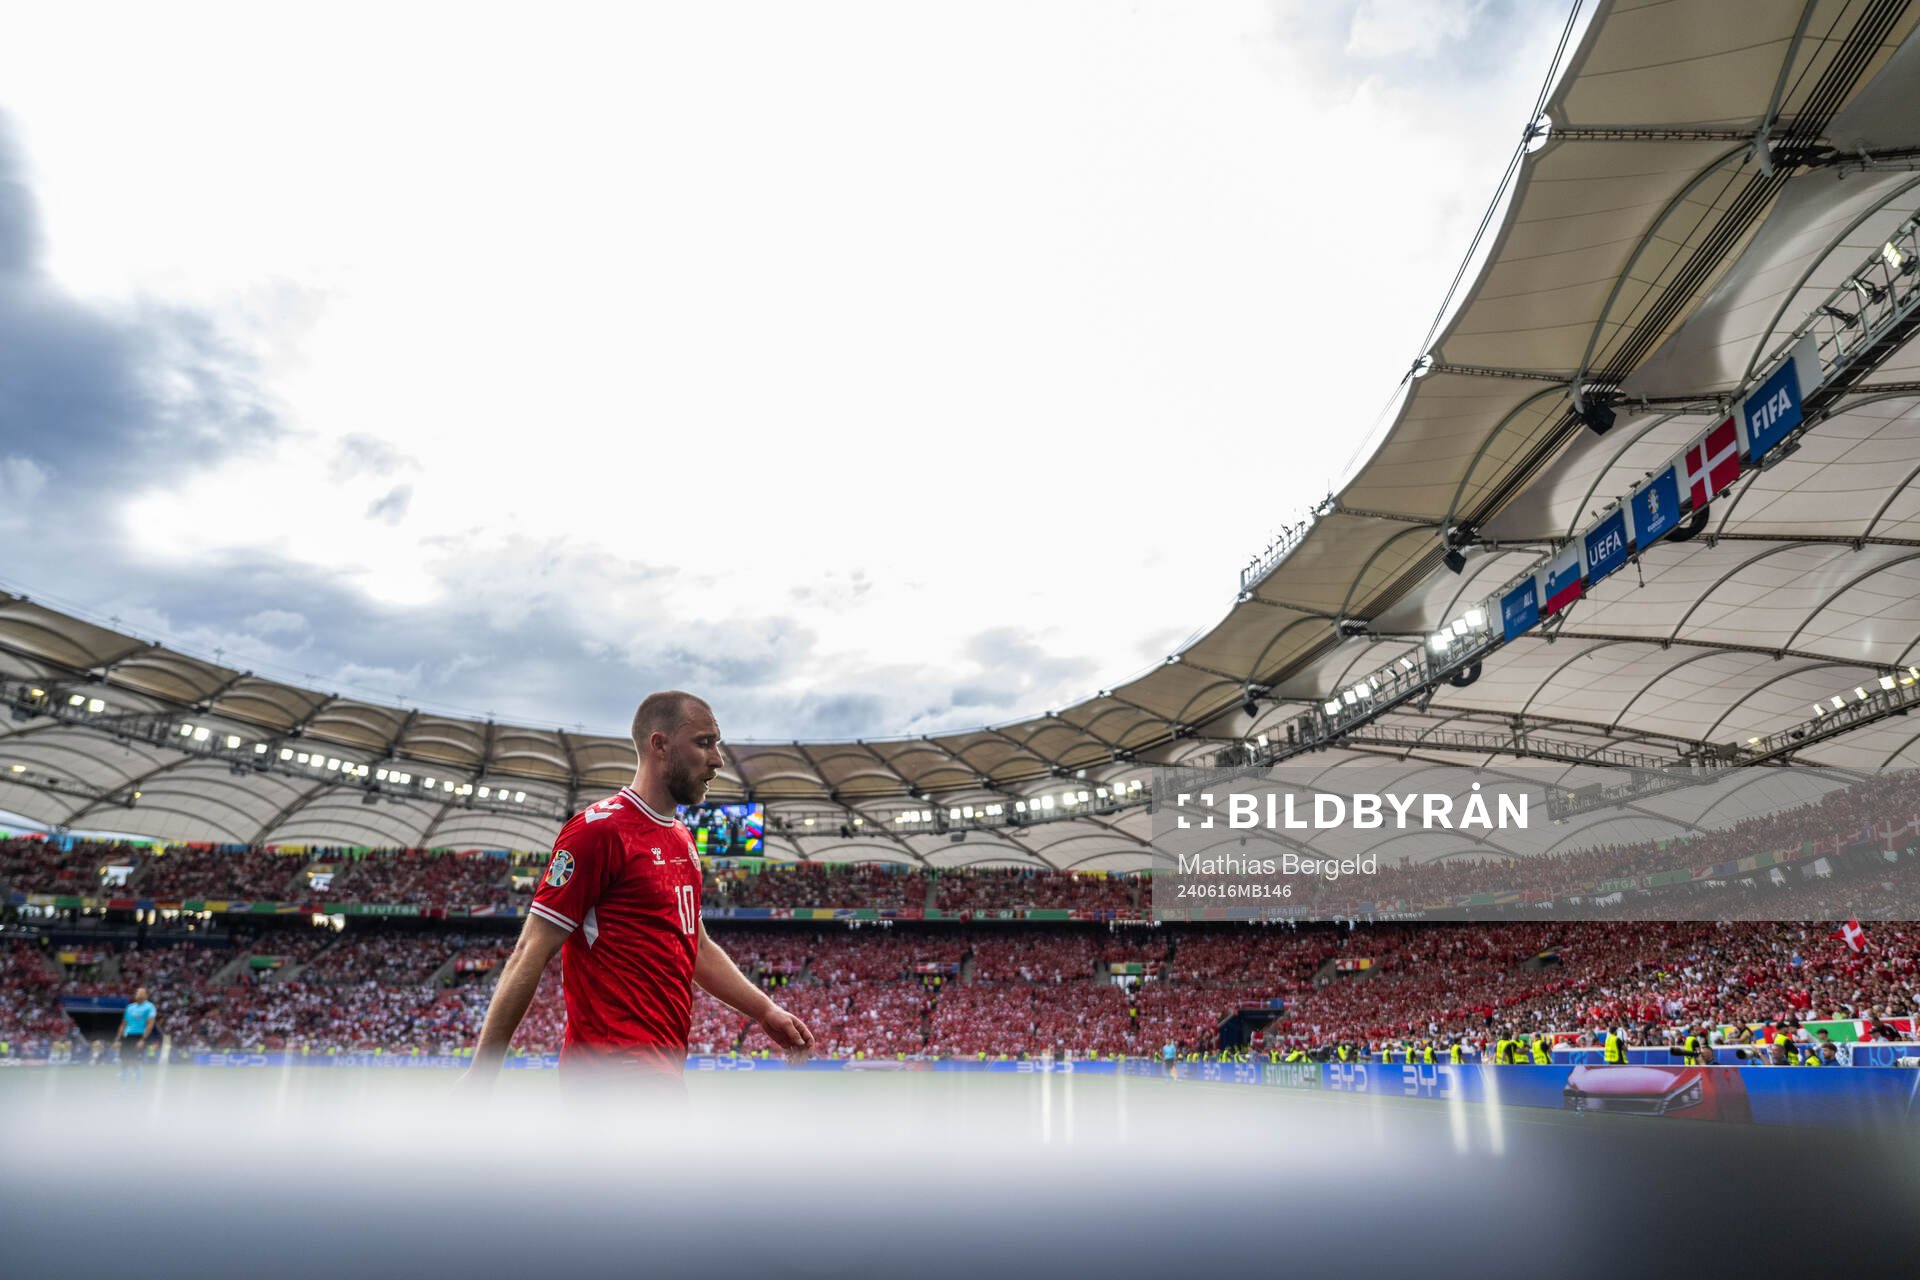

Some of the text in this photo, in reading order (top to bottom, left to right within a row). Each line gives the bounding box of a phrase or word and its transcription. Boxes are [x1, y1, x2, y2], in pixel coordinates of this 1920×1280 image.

[1752, 387, 1792, 439] FIFA
[1589, 530, 1622, 566] UEFA
[362, 904, 418, 915] STUTTGA
[675, 885, 695, 935] 10
[1266, 1065, 1316, 1087] STUTTGART
[1331, 1066, 1368, 1092] BYD
[1402, 1065, 1456, 1098] BYD
